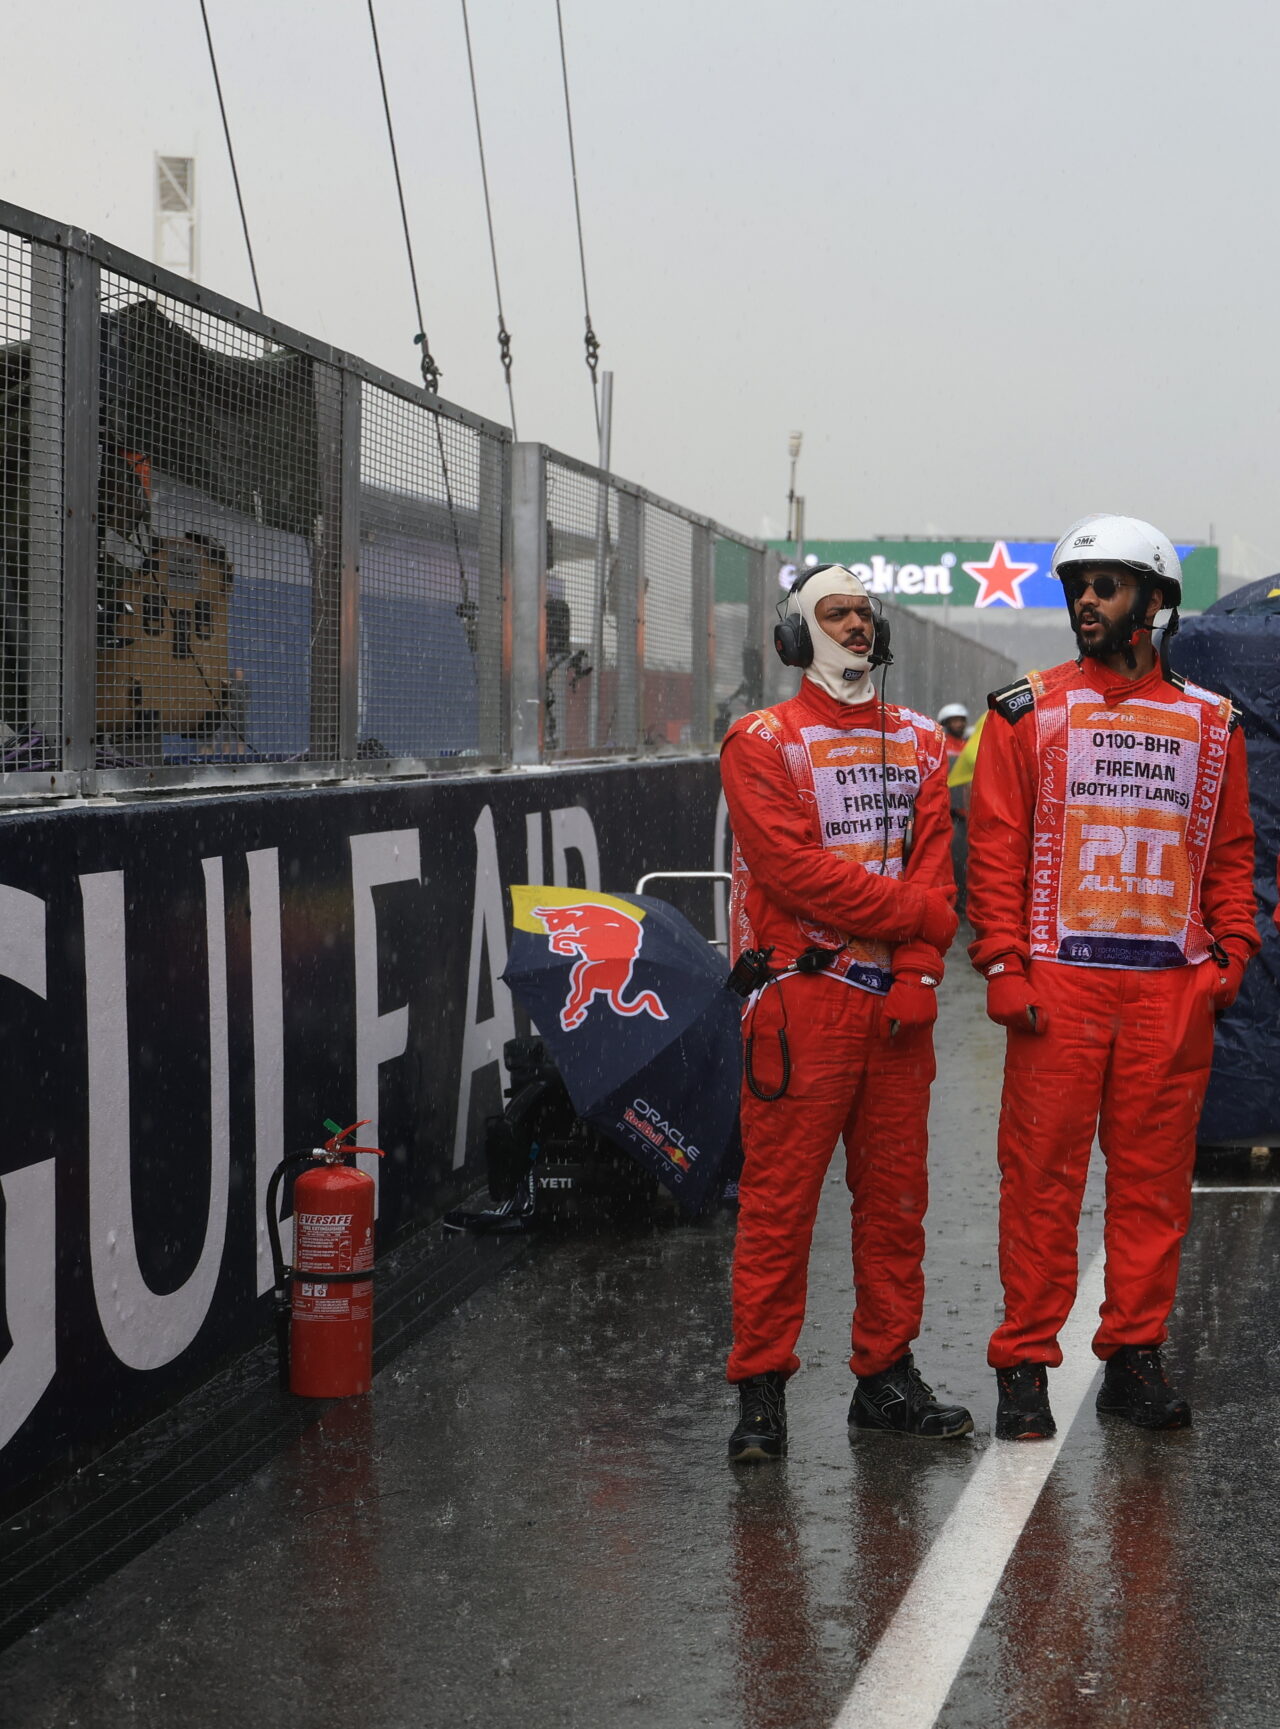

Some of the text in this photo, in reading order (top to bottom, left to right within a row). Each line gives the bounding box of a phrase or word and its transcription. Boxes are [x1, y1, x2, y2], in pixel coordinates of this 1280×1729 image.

[1073, 537, 1097, 546] OMP
[1008, 693, 1032, 710] OMP
[1092, 733, 1181, 756] 0100-BHR
[1095, 758, 1176, 782] FIREMAN
[1070, 781, 1190, 810] (BOTH PIT LANES)
[1194, 725, 1227, 847] BAHRAIN
[843, 793, 914, 813] FIREMAN
[825, 818, 872, 839] (BOTH
[1078, 823, 1181, 876] PIT
[1031, 832, 1053, 954] BAHRAIN
[1078, 874, 1122, 893] ALL
[632, 1098, 701, 1161] ORACLE
[615, 1121, 684, 1184] RACING
[540, 1177, 572, 1189] YETI
[300, 1214, 351, 1225] EVERSAFE
